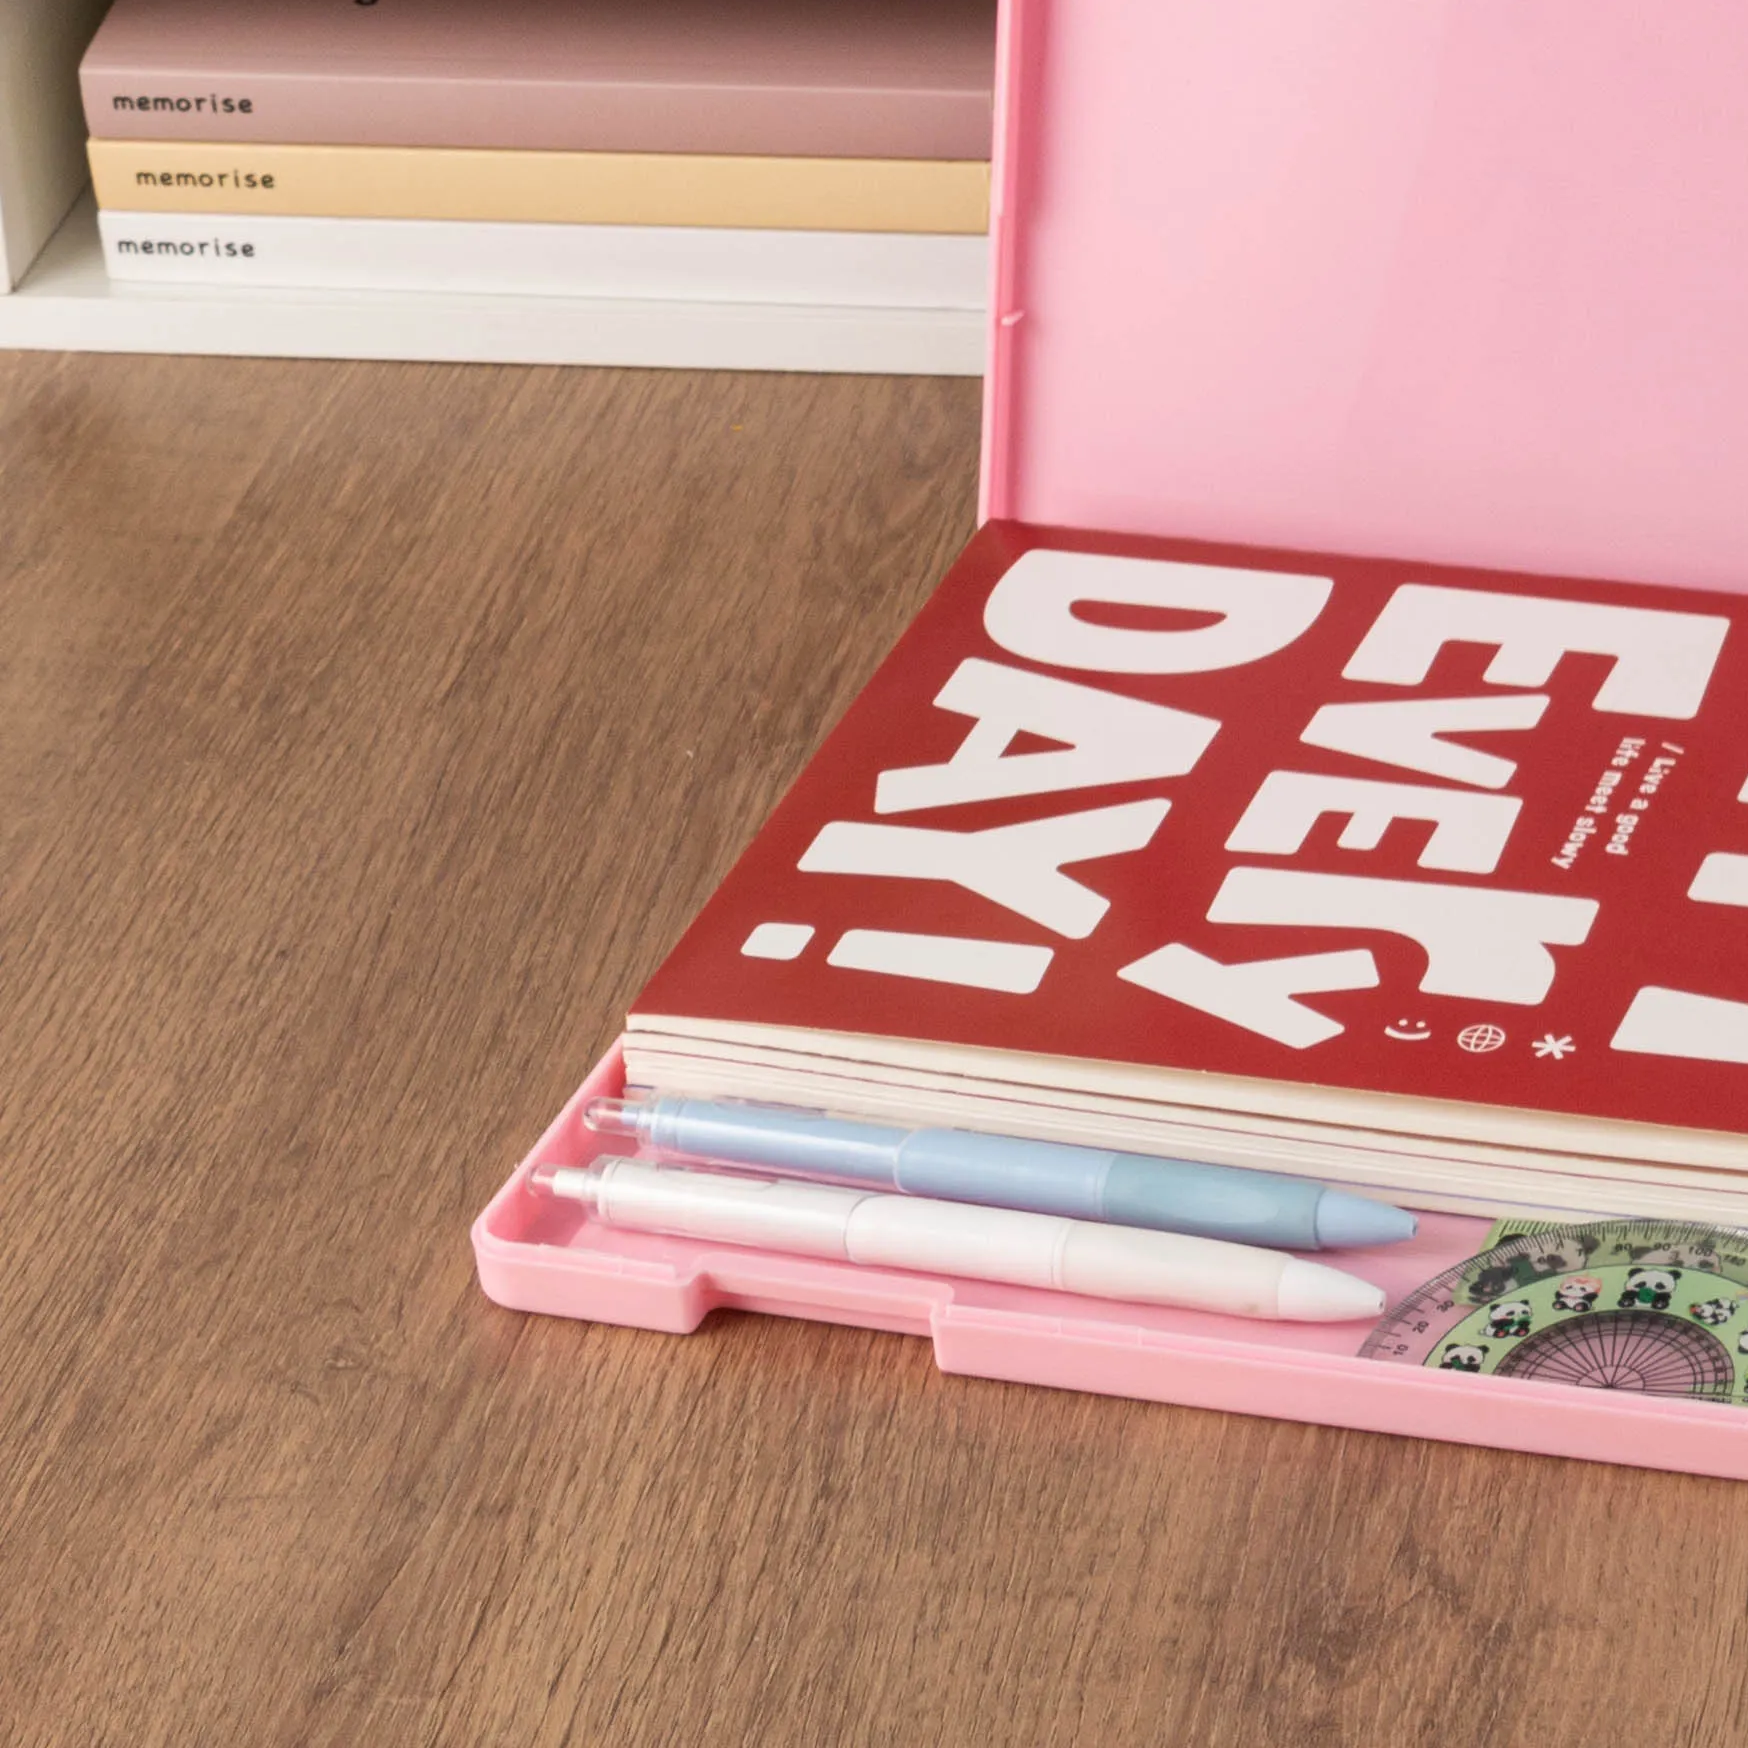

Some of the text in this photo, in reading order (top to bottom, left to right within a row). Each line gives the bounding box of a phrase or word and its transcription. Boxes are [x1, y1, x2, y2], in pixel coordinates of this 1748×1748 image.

[112, 94, 253, 114] memorise
[136, 169, 275, 190] memorise
[118, 237, 255, 258] memorise
[1611, 737, 1646, 767] life
[742, 550, 1333, 993] DAY!
[1639, 757, 1677, 794] Live
[1585, 770, 1623, 813] meet
[1629, 798, 1649, 810] a
[1605, 814, 1640, 855] good
[1412, 1320, 1430, 1334] 20
[1653, 1241, 1672, 1252] 90
